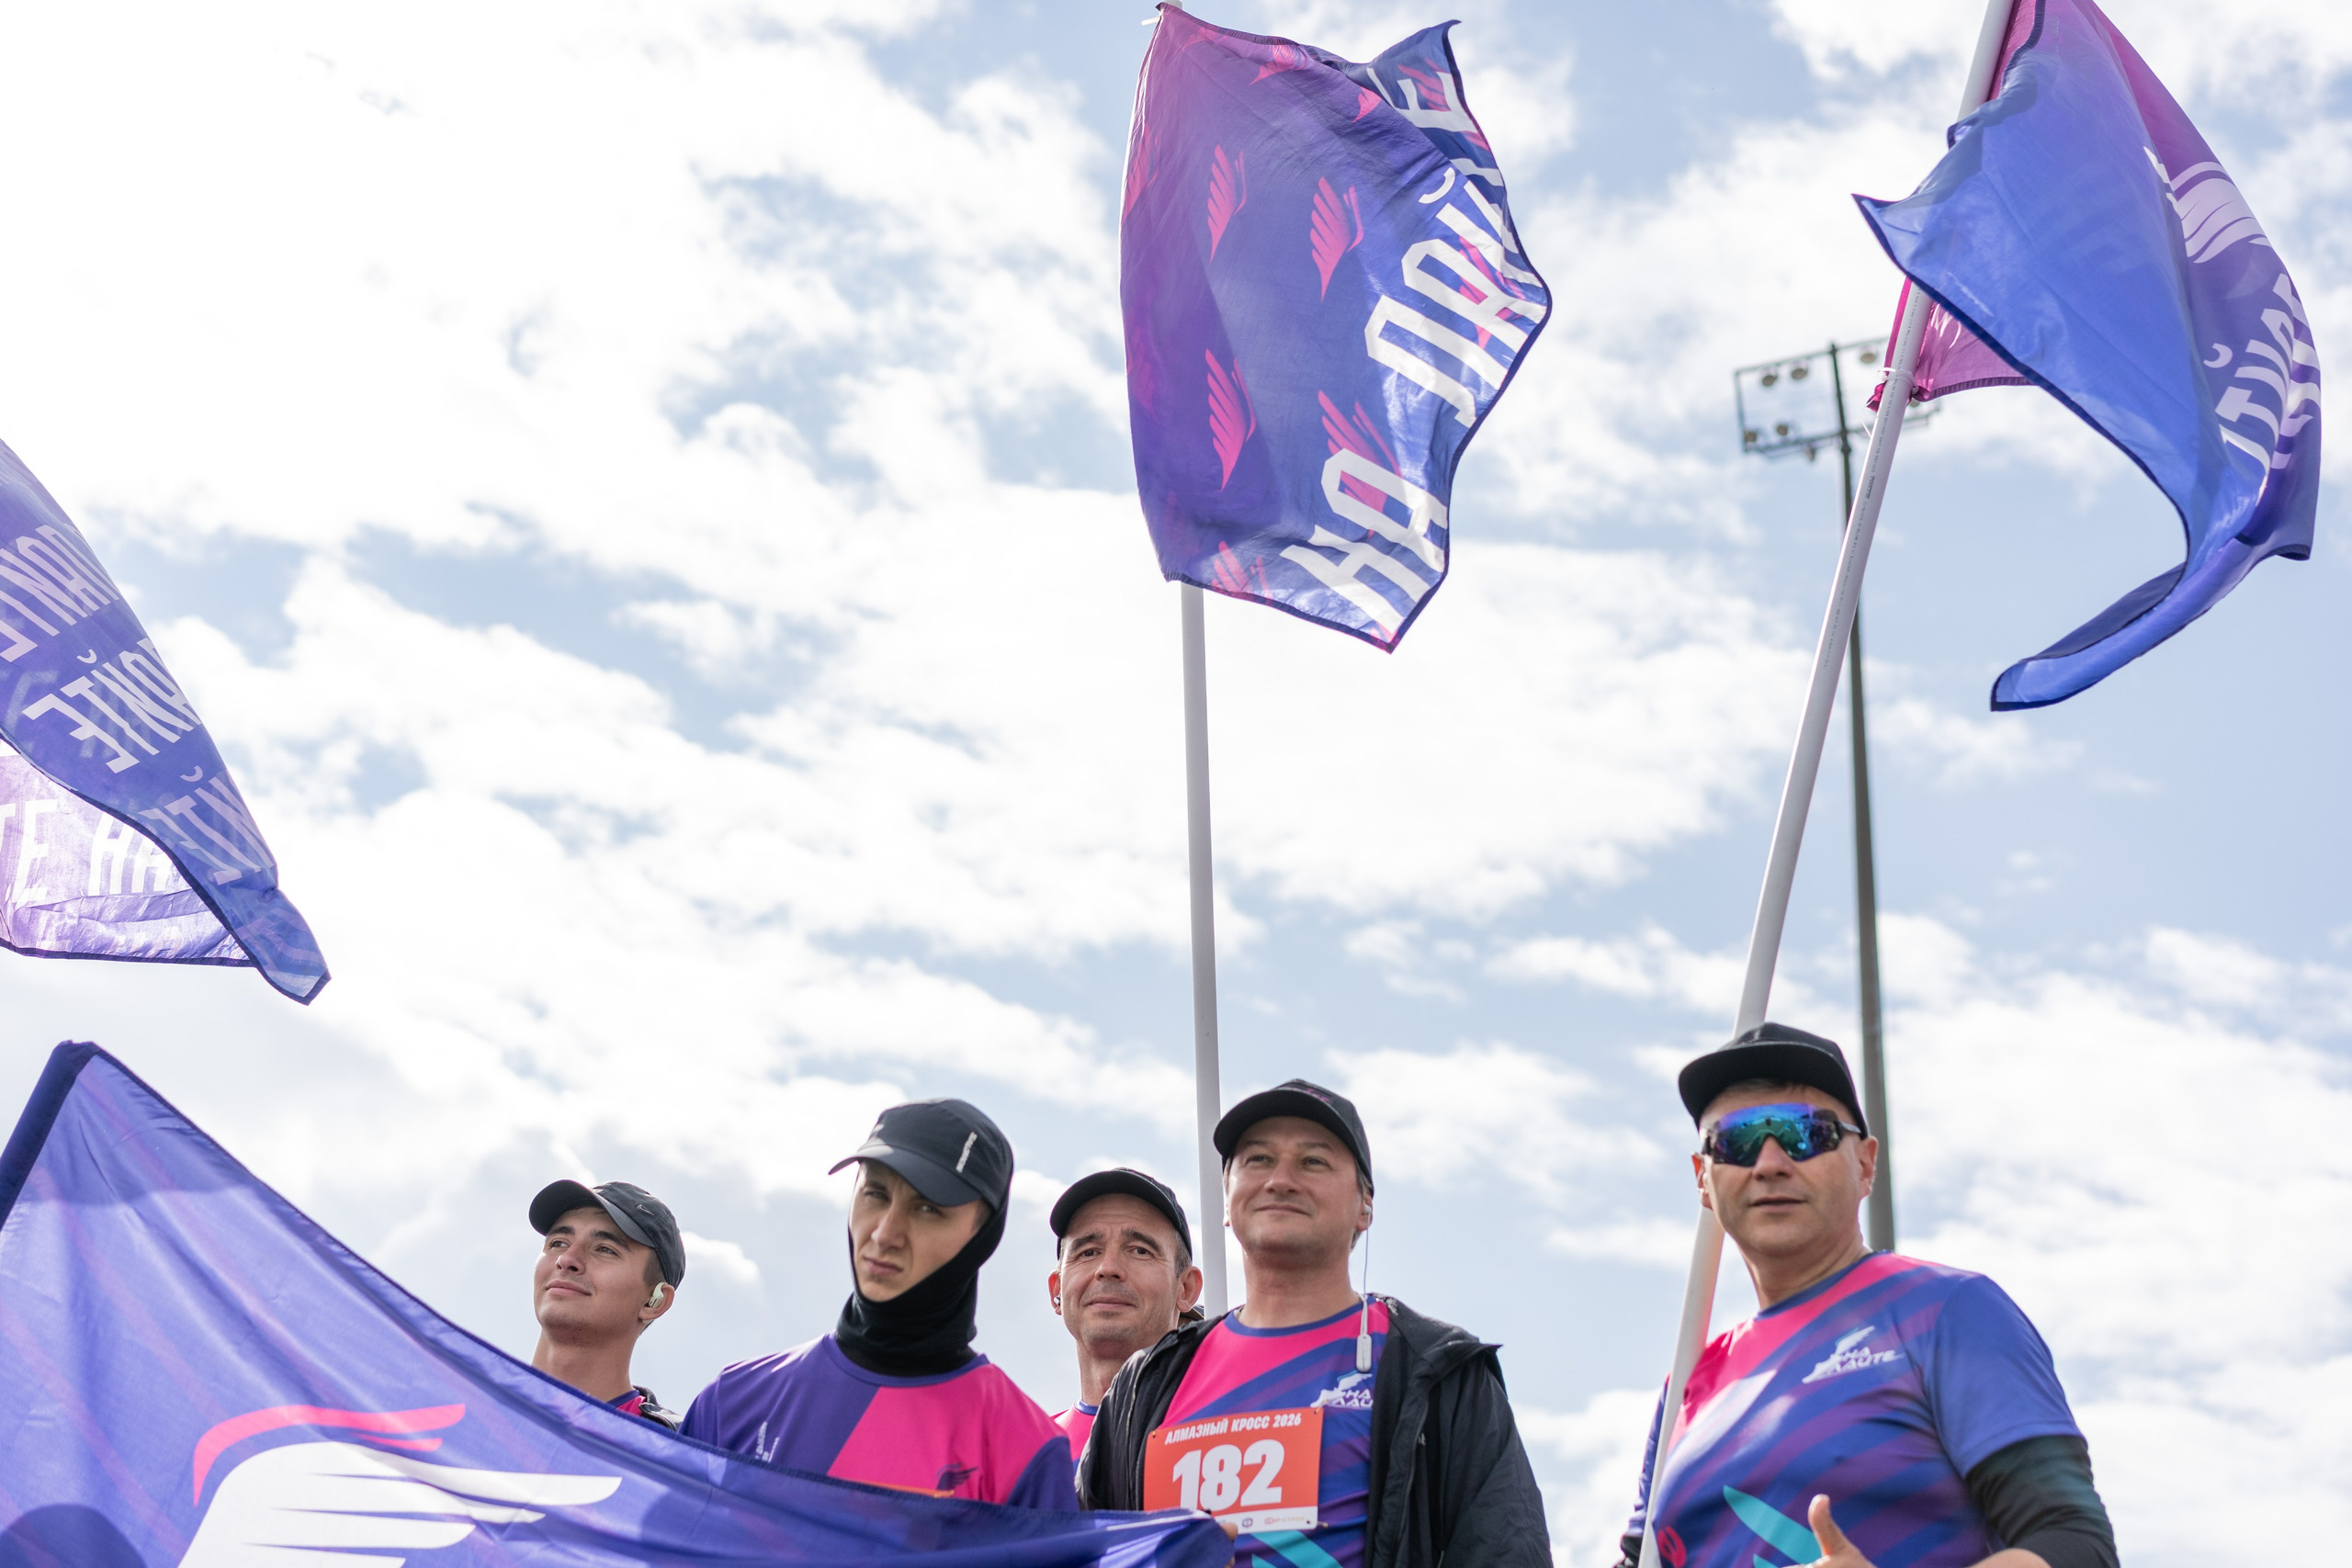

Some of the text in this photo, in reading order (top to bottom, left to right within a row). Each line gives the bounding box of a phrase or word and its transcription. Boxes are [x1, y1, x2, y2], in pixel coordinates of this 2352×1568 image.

[1279, 447, 1449, 636] НА
[1164, 1413, 1302, 1446] АЛМАЗНЫЙ КРОСС 2026
[1172, 1438, 1285, 1512] 182
